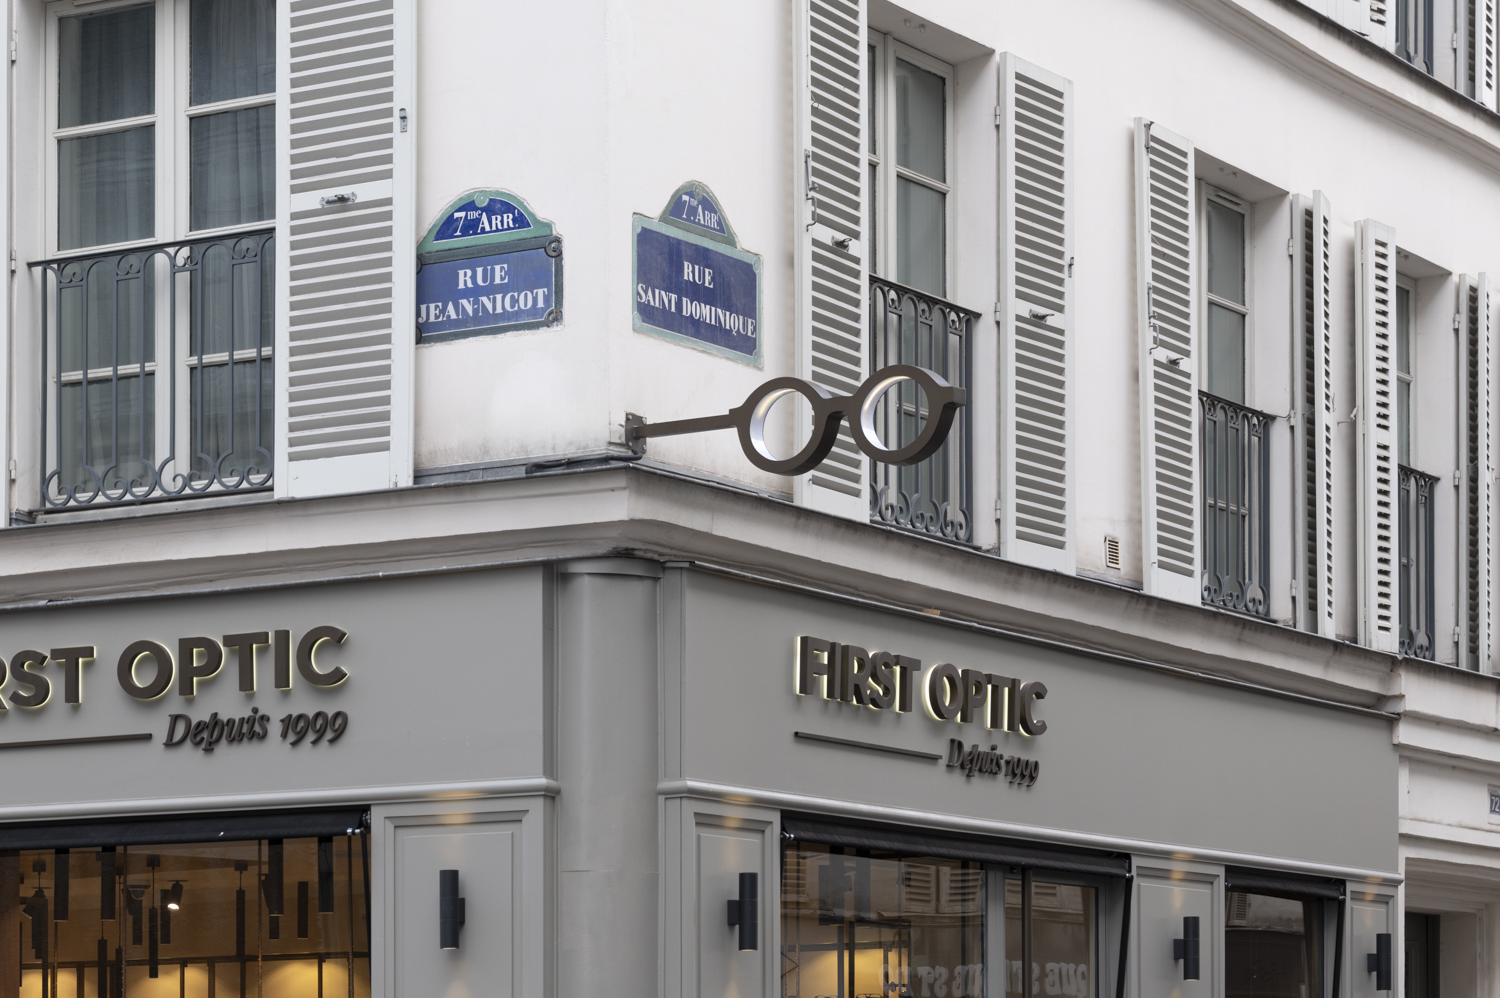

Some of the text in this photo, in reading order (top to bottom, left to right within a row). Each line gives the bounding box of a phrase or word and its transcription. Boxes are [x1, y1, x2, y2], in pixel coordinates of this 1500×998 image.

[457, 263, 508, 289] RUE
[683, 260, 714, 289] RUE
[417, 286, 548, 325] JEAN-NICOT
[637, 282, 757, 339] SAINT DOMINIQUE
[116, 625, 350, 700] OPTIC
[795, 635, 1048, 737] FIRST OPTIC
[162, 705, 349, 751] Depuis 1999
[946, 737, 1040, 787] Depuis 1999
[1491, 796, 1500, 812] 72
